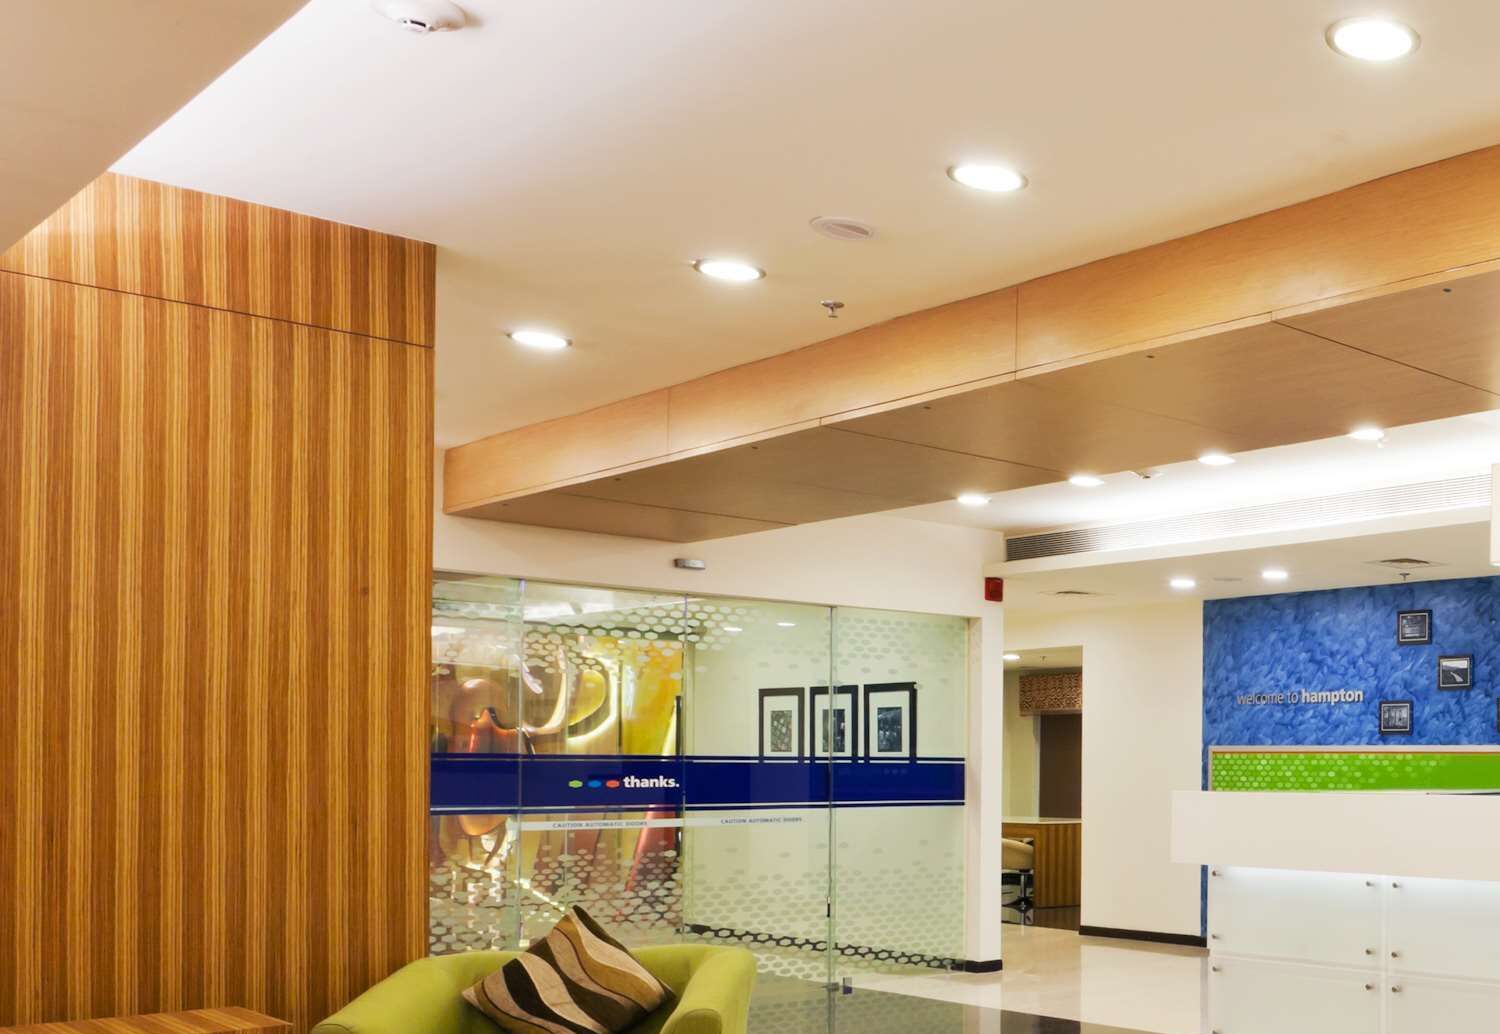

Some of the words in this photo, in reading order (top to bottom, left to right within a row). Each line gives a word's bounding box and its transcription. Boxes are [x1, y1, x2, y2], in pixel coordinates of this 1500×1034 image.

[1237, 690, 1284, 704] welcome
[1287, 689, 1298, 703] to
[1301, 688, 1363, 705] hampton
[623, 775, 680, 788] thanks.
